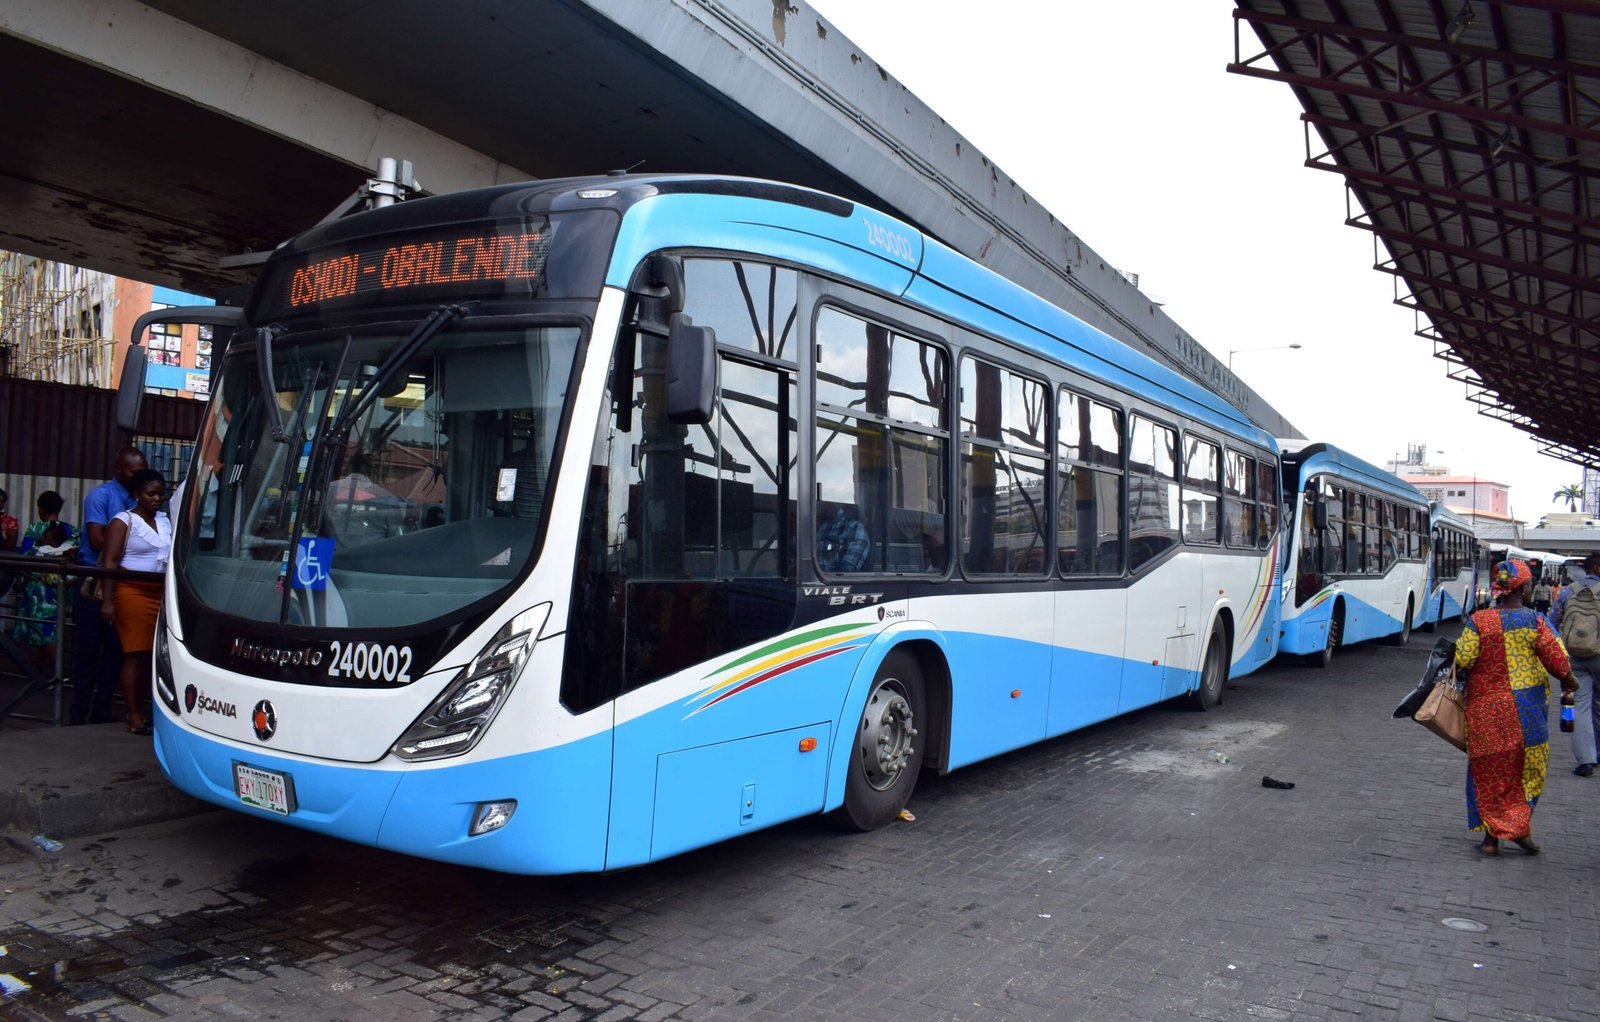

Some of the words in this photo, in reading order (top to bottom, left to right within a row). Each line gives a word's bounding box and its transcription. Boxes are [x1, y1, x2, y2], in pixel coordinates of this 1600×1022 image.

[290, 253, 360, 307] OSHODI
[380, 233, 540, 289] OBALENDE
[803, 586, 850, 596] VIALE
[829, 593, 883, 606] BRT
[885, 610, 905, 619] SCANIA
[230, 638, 323, 667] Marcopolo
[328, 640, 413, 683] 240002
[197, 695, 237, 719] SCANIA
